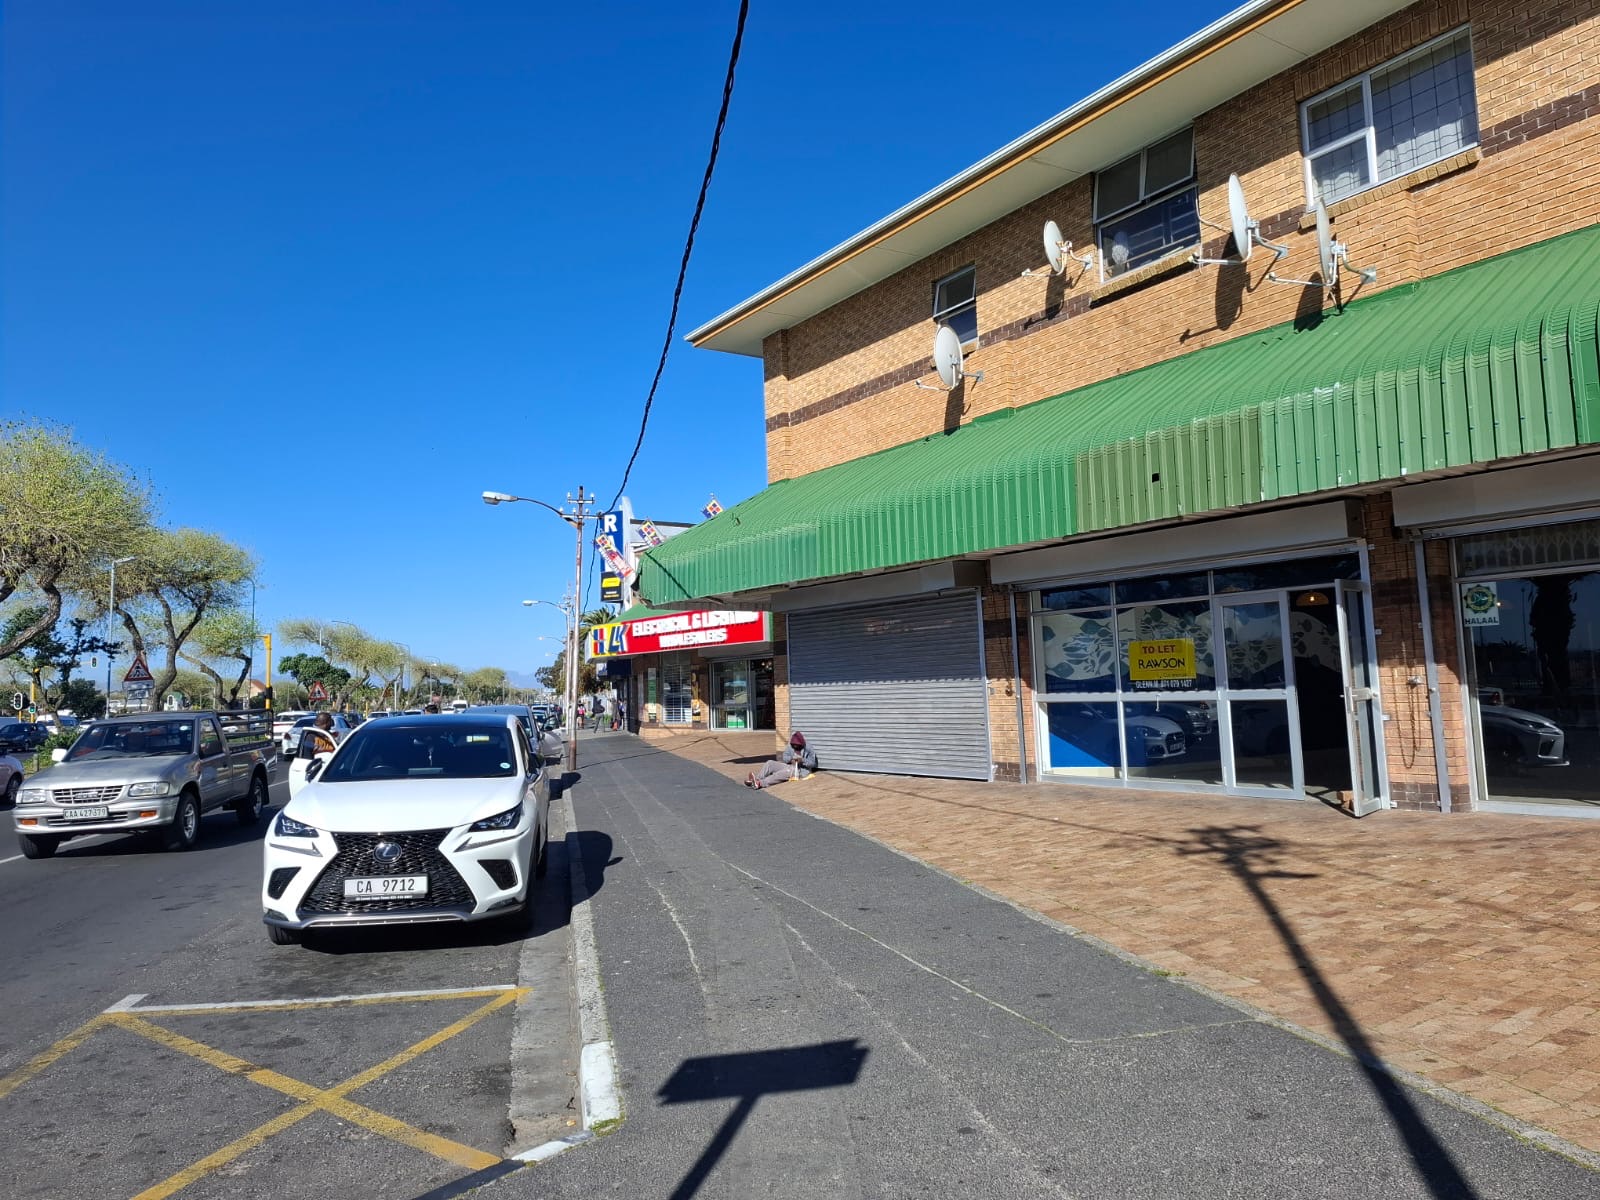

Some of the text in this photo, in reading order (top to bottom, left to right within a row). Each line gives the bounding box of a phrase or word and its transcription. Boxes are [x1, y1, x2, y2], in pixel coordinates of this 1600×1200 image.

[1464, 616, 1499, 624] HALAAL
[1142, 645, 1175, 654] TO LET
[1138, 658, 1185, 669] RAWSON
[356, 878, 415, 893] CA 9712
